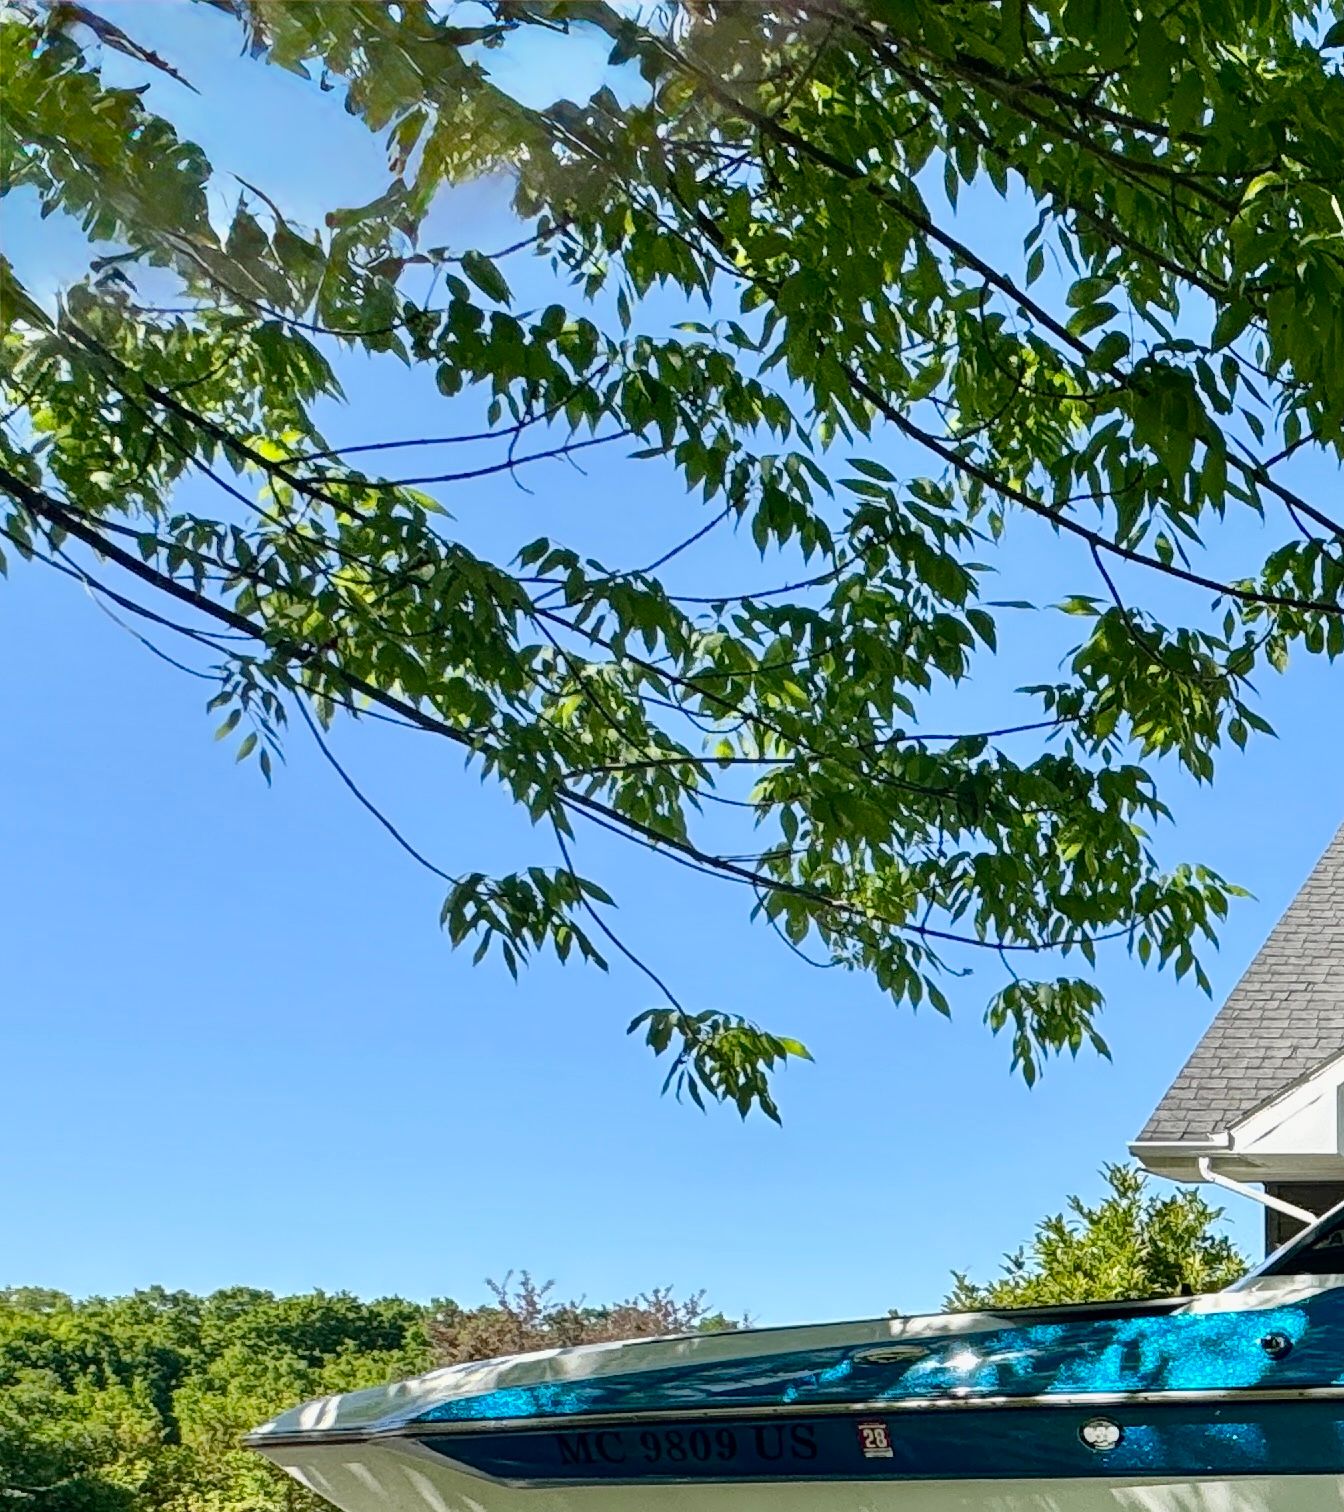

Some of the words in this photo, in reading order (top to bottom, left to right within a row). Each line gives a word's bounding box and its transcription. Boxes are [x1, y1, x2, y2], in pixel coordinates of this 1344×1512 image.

[556, 1430, 627, 1465] MC
[640, 1428, 737, 1463] 9809
[752, 1424, 818, 1461] US
[863, 1428, 888, 1448] 28
